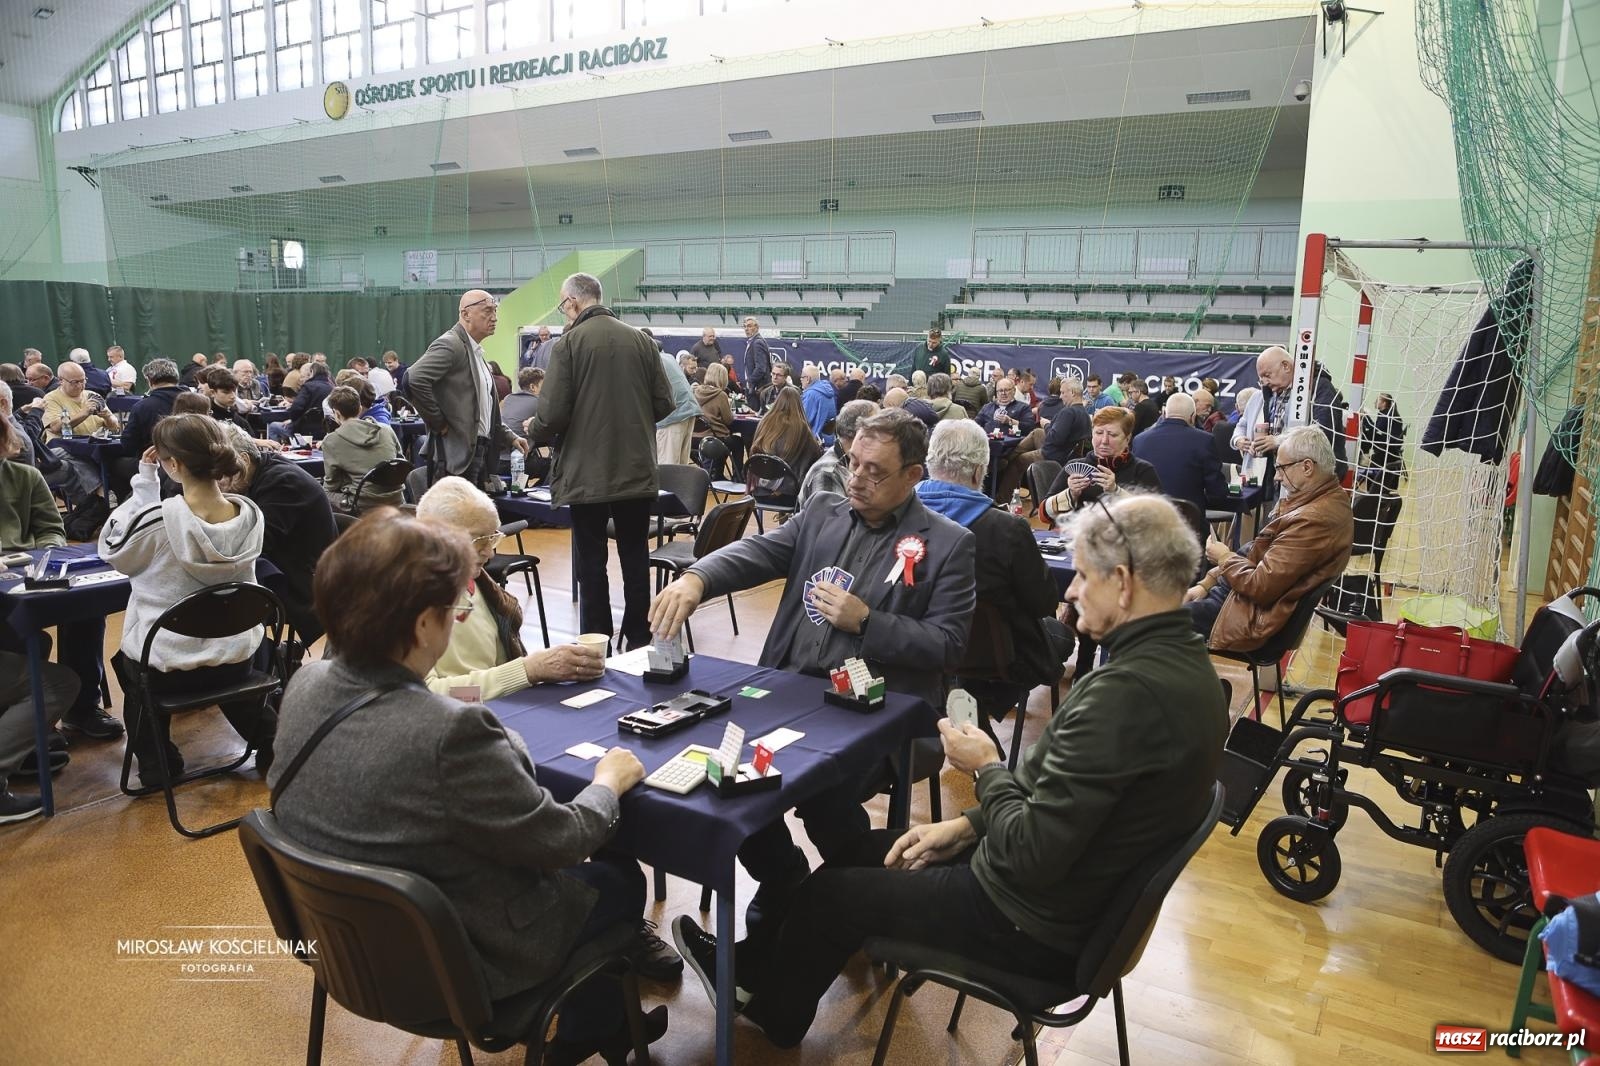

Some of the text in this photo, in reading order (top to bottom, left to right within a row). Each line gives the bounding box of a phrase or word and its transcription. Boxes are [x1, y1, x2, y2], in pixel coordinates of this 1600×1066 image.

[355, 37, 668, 107] OŚRODEK SPORTU I REKREACJI RACIBÓRZ
